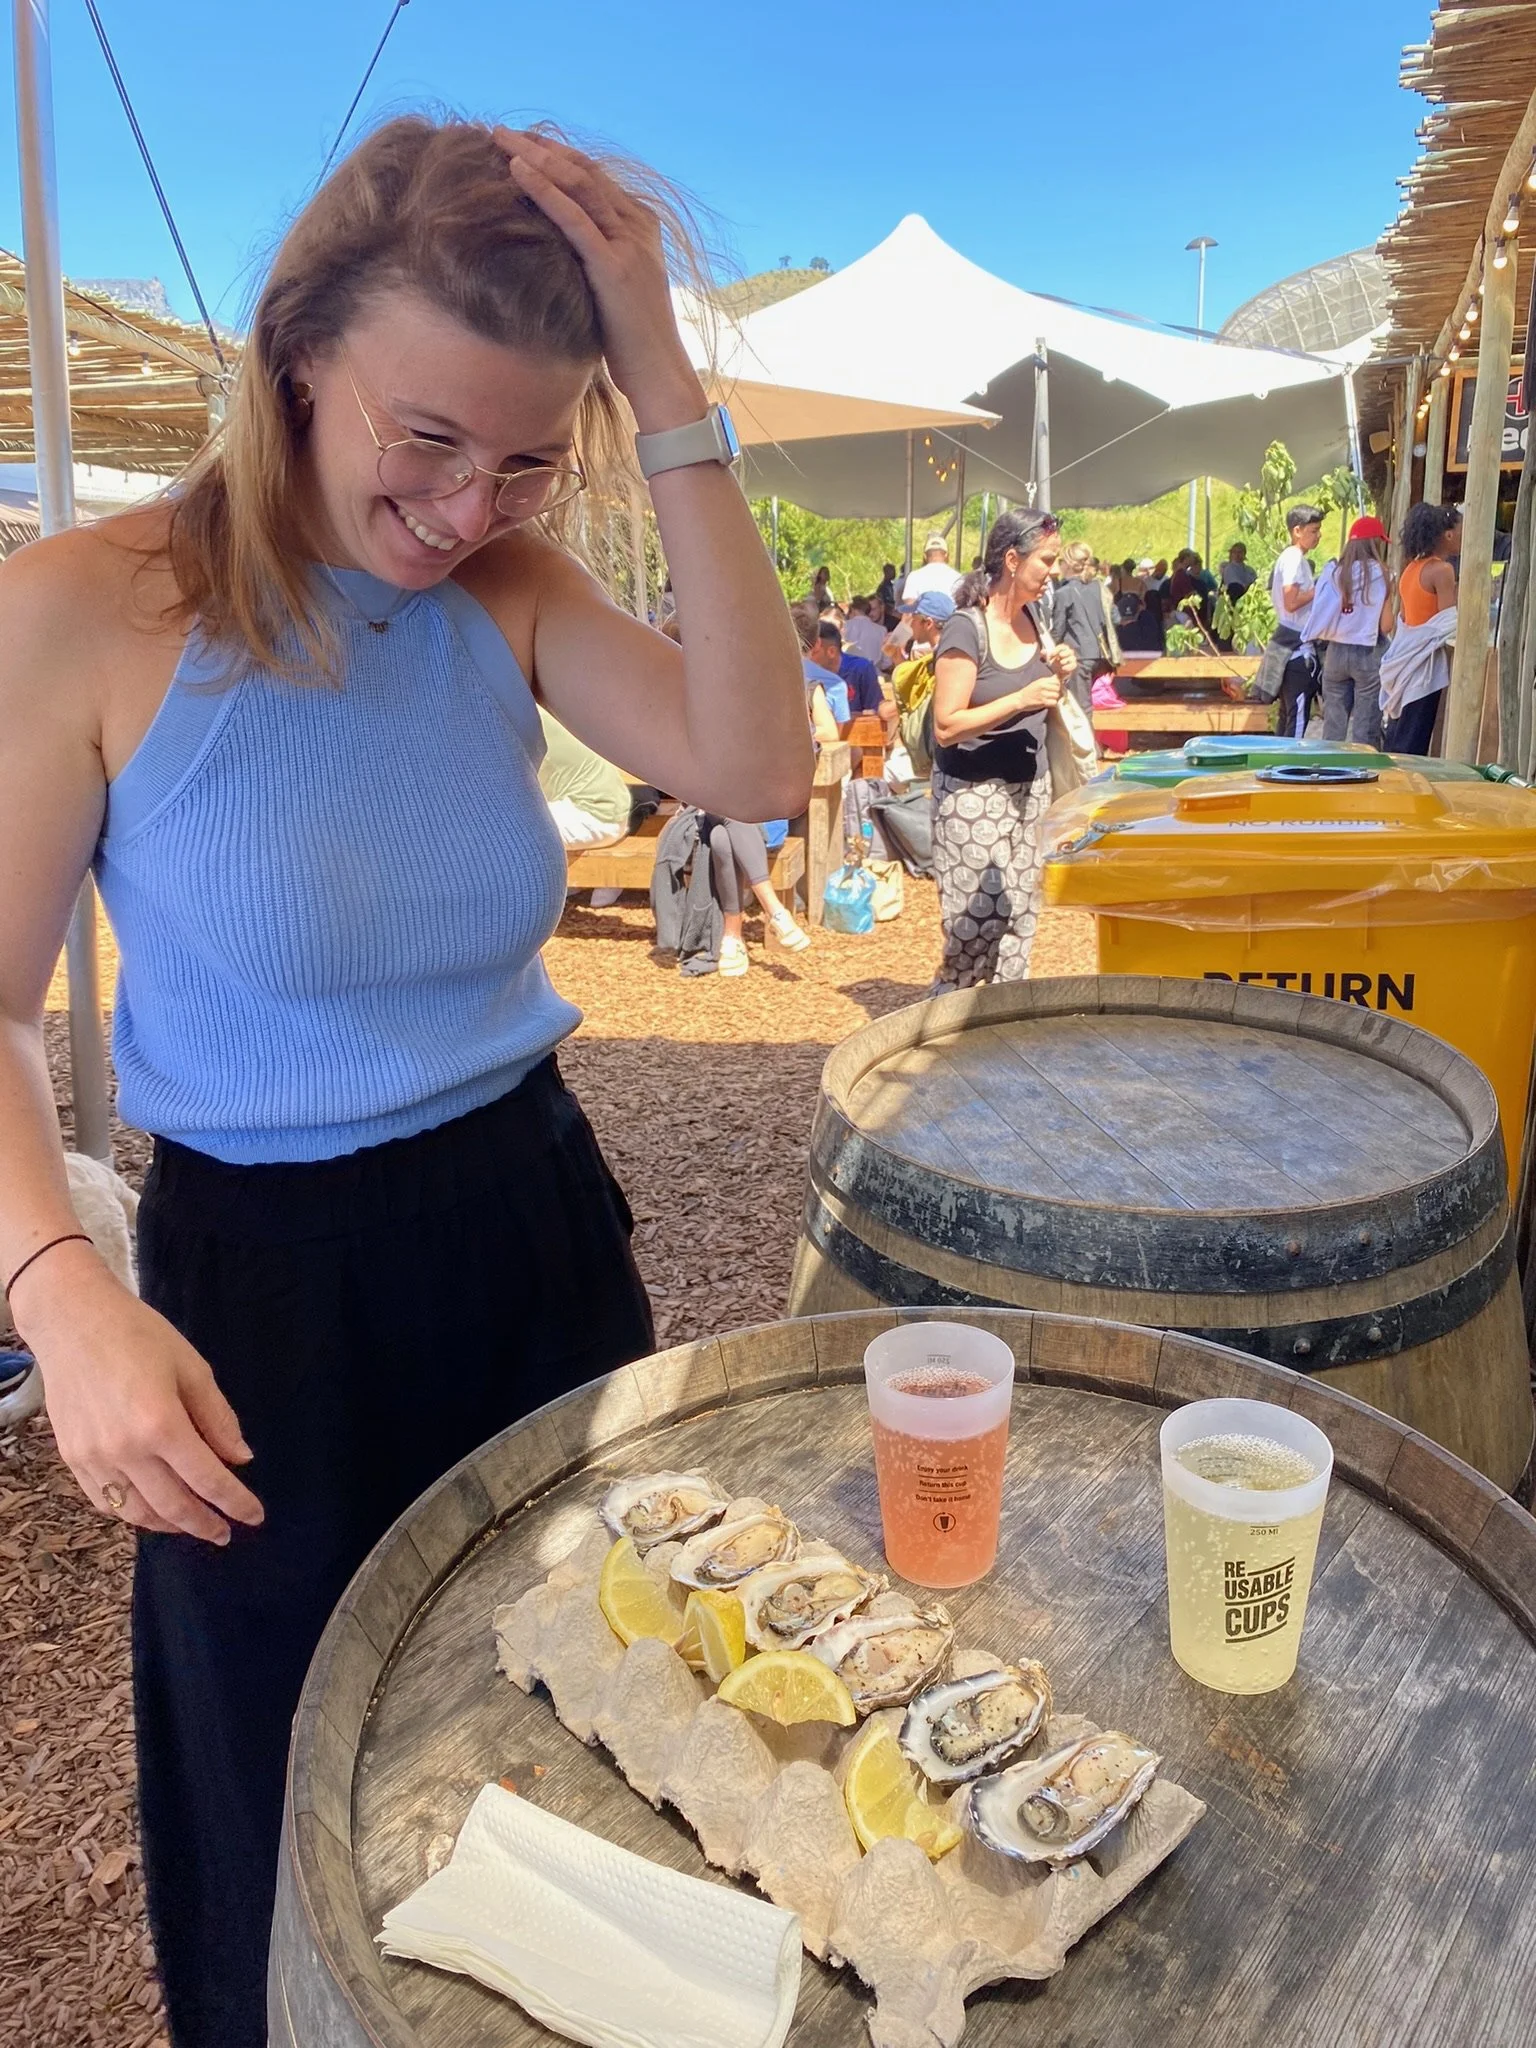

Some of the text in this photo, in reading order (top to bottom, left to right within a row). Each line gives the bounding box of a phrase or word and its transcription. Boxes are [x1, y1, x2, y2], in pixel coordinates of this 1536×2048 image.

[1229, 818, 1270, 828] NO
[917, 1465, 934, 1474] Enjoy
[952, 1464, 968, 1473] drink
[920, 1480, 940, 1488] Return
[954, 1480, 967, 1488] cup
[916, 1494, 931, 1502] Don't
[1250, 1528, 1266, 1536] 250
[1224, 1561, 1246, 1578] RE
[1224, 1562, 1295, 1600] USABLE
[1225, 1592, 1291, 1637] CUPS
